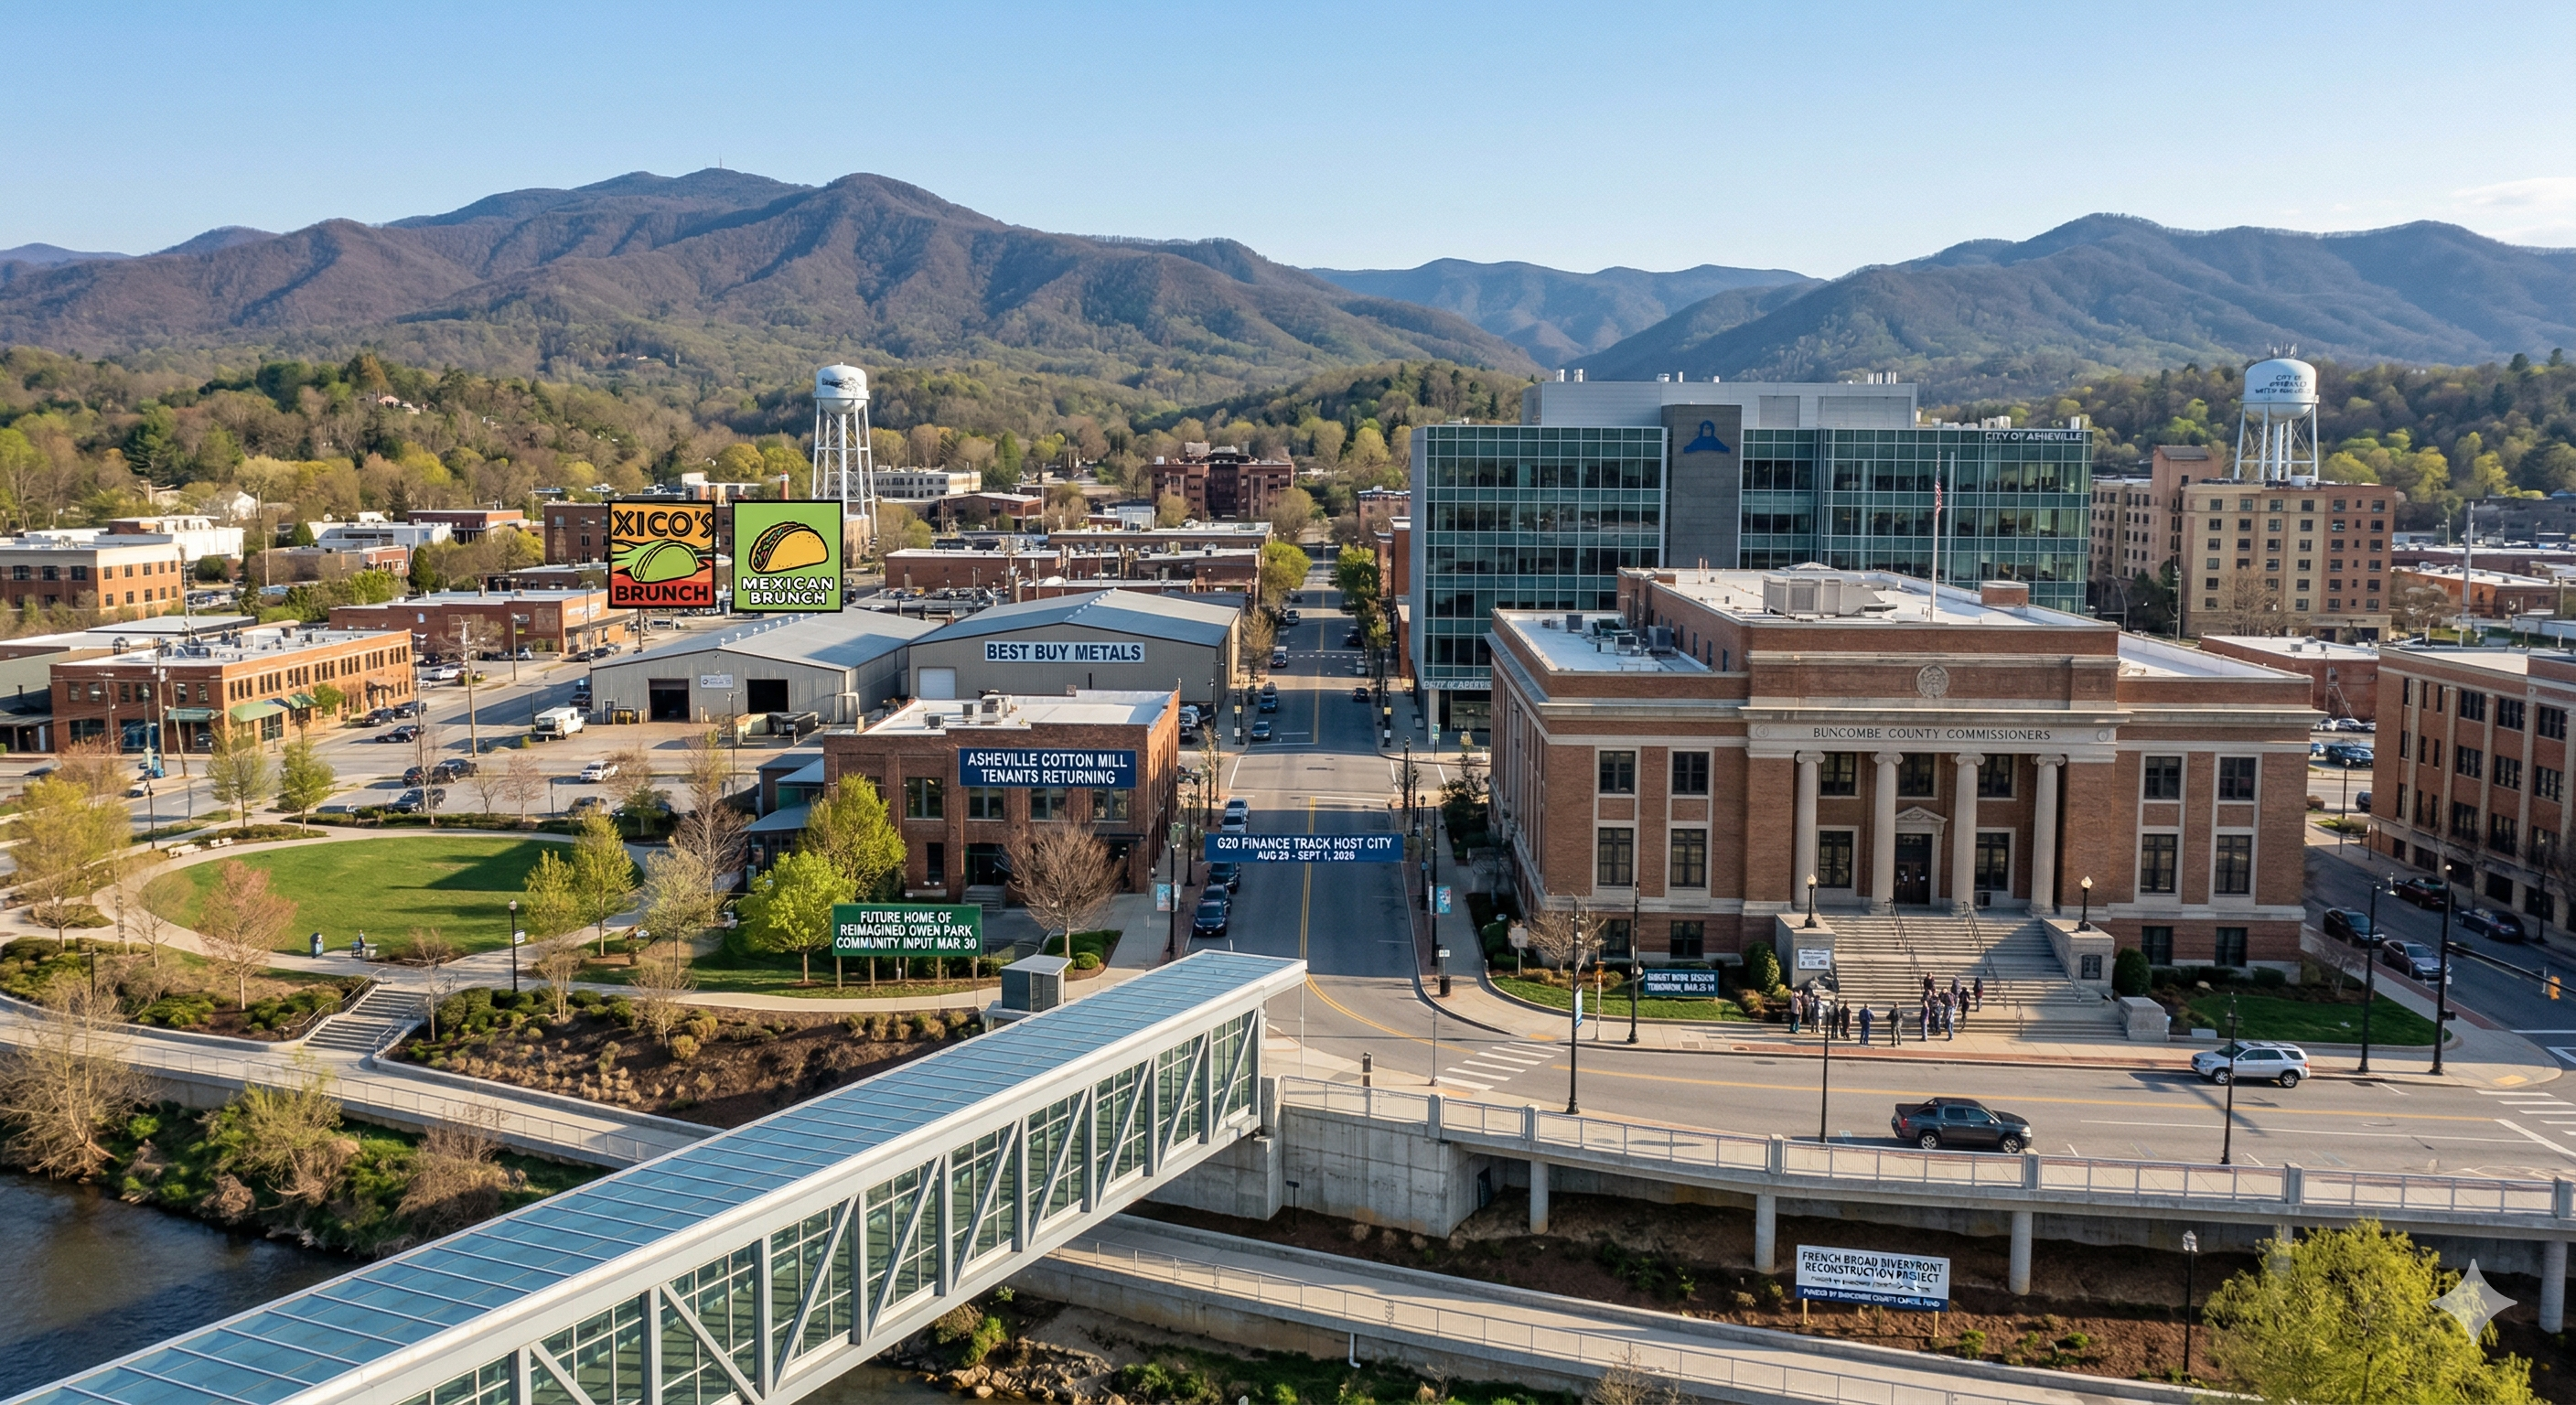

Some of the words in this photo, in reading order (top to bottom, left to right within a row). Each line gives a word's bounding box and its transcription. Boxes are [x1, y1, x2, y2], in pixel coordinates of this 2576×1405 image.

[1985, 432, 2009, 440] CITY
[613, 509, 714, 538] XICO'S
[742, 576, 834, 591] MEXICAN
[615, 585, 709, 602] BRUNCH
[750, 590, 827, 605] BRUNCH
[987, 643, 1029, 660] BEST
[1035, 644, 1068, 660] BUY
[1075, 644, 1141, 660] METALS
[1813, 727, 1882, 738] BUNCOMBE
[1888, 728, 1940, 739] COUNTY
[1947, 728, 2051, 740] COMMISSIONERS
[968, 752, 1037, 767] ASHEVILLE
[1041, 753, 1093, 767] COTTON
[1098, 754, 1128, 767] MILL
[981, 768, 1038, 783] TENANTS
[1042, 770, 1116, 784] RETURNING
[1217, 837, 1239, 850] G20
[1241, 837, 1290, 850] FINANCE
[1293, 837, 1331, 850] TRACK
[1334, 837, 1364, 850] HOST
[1367, 837, 1392, 850] CITY
[1257, 851, 1277, 860] AUG
[1278, 851, 1290, 860] 29
[1297, 851, 1320, 860] SEPT
[1323, 851, 1331, 862] 1,
[1333, 851, 1355, 860] 2026
[860, 911, 901, 923] FUTURE
[904, 911, 935, 923] HOME
[938, 911, 952, 923] OF
[840, 924, 906, 937] REIMAGINED
[908, 924, 940, 937] OWEN
[943, 925, 973, 938] PARK
[836, 938, 899, 949] COMMUNITY
[903, 938, 934, 949] INPUT
[937, 938, 961, 949] MAR
[963, 938, 977, 949] 30
[1802, 1251, 1841, 1263] FRENCH
[1843, 1254, 1878, 1268] BROAD
